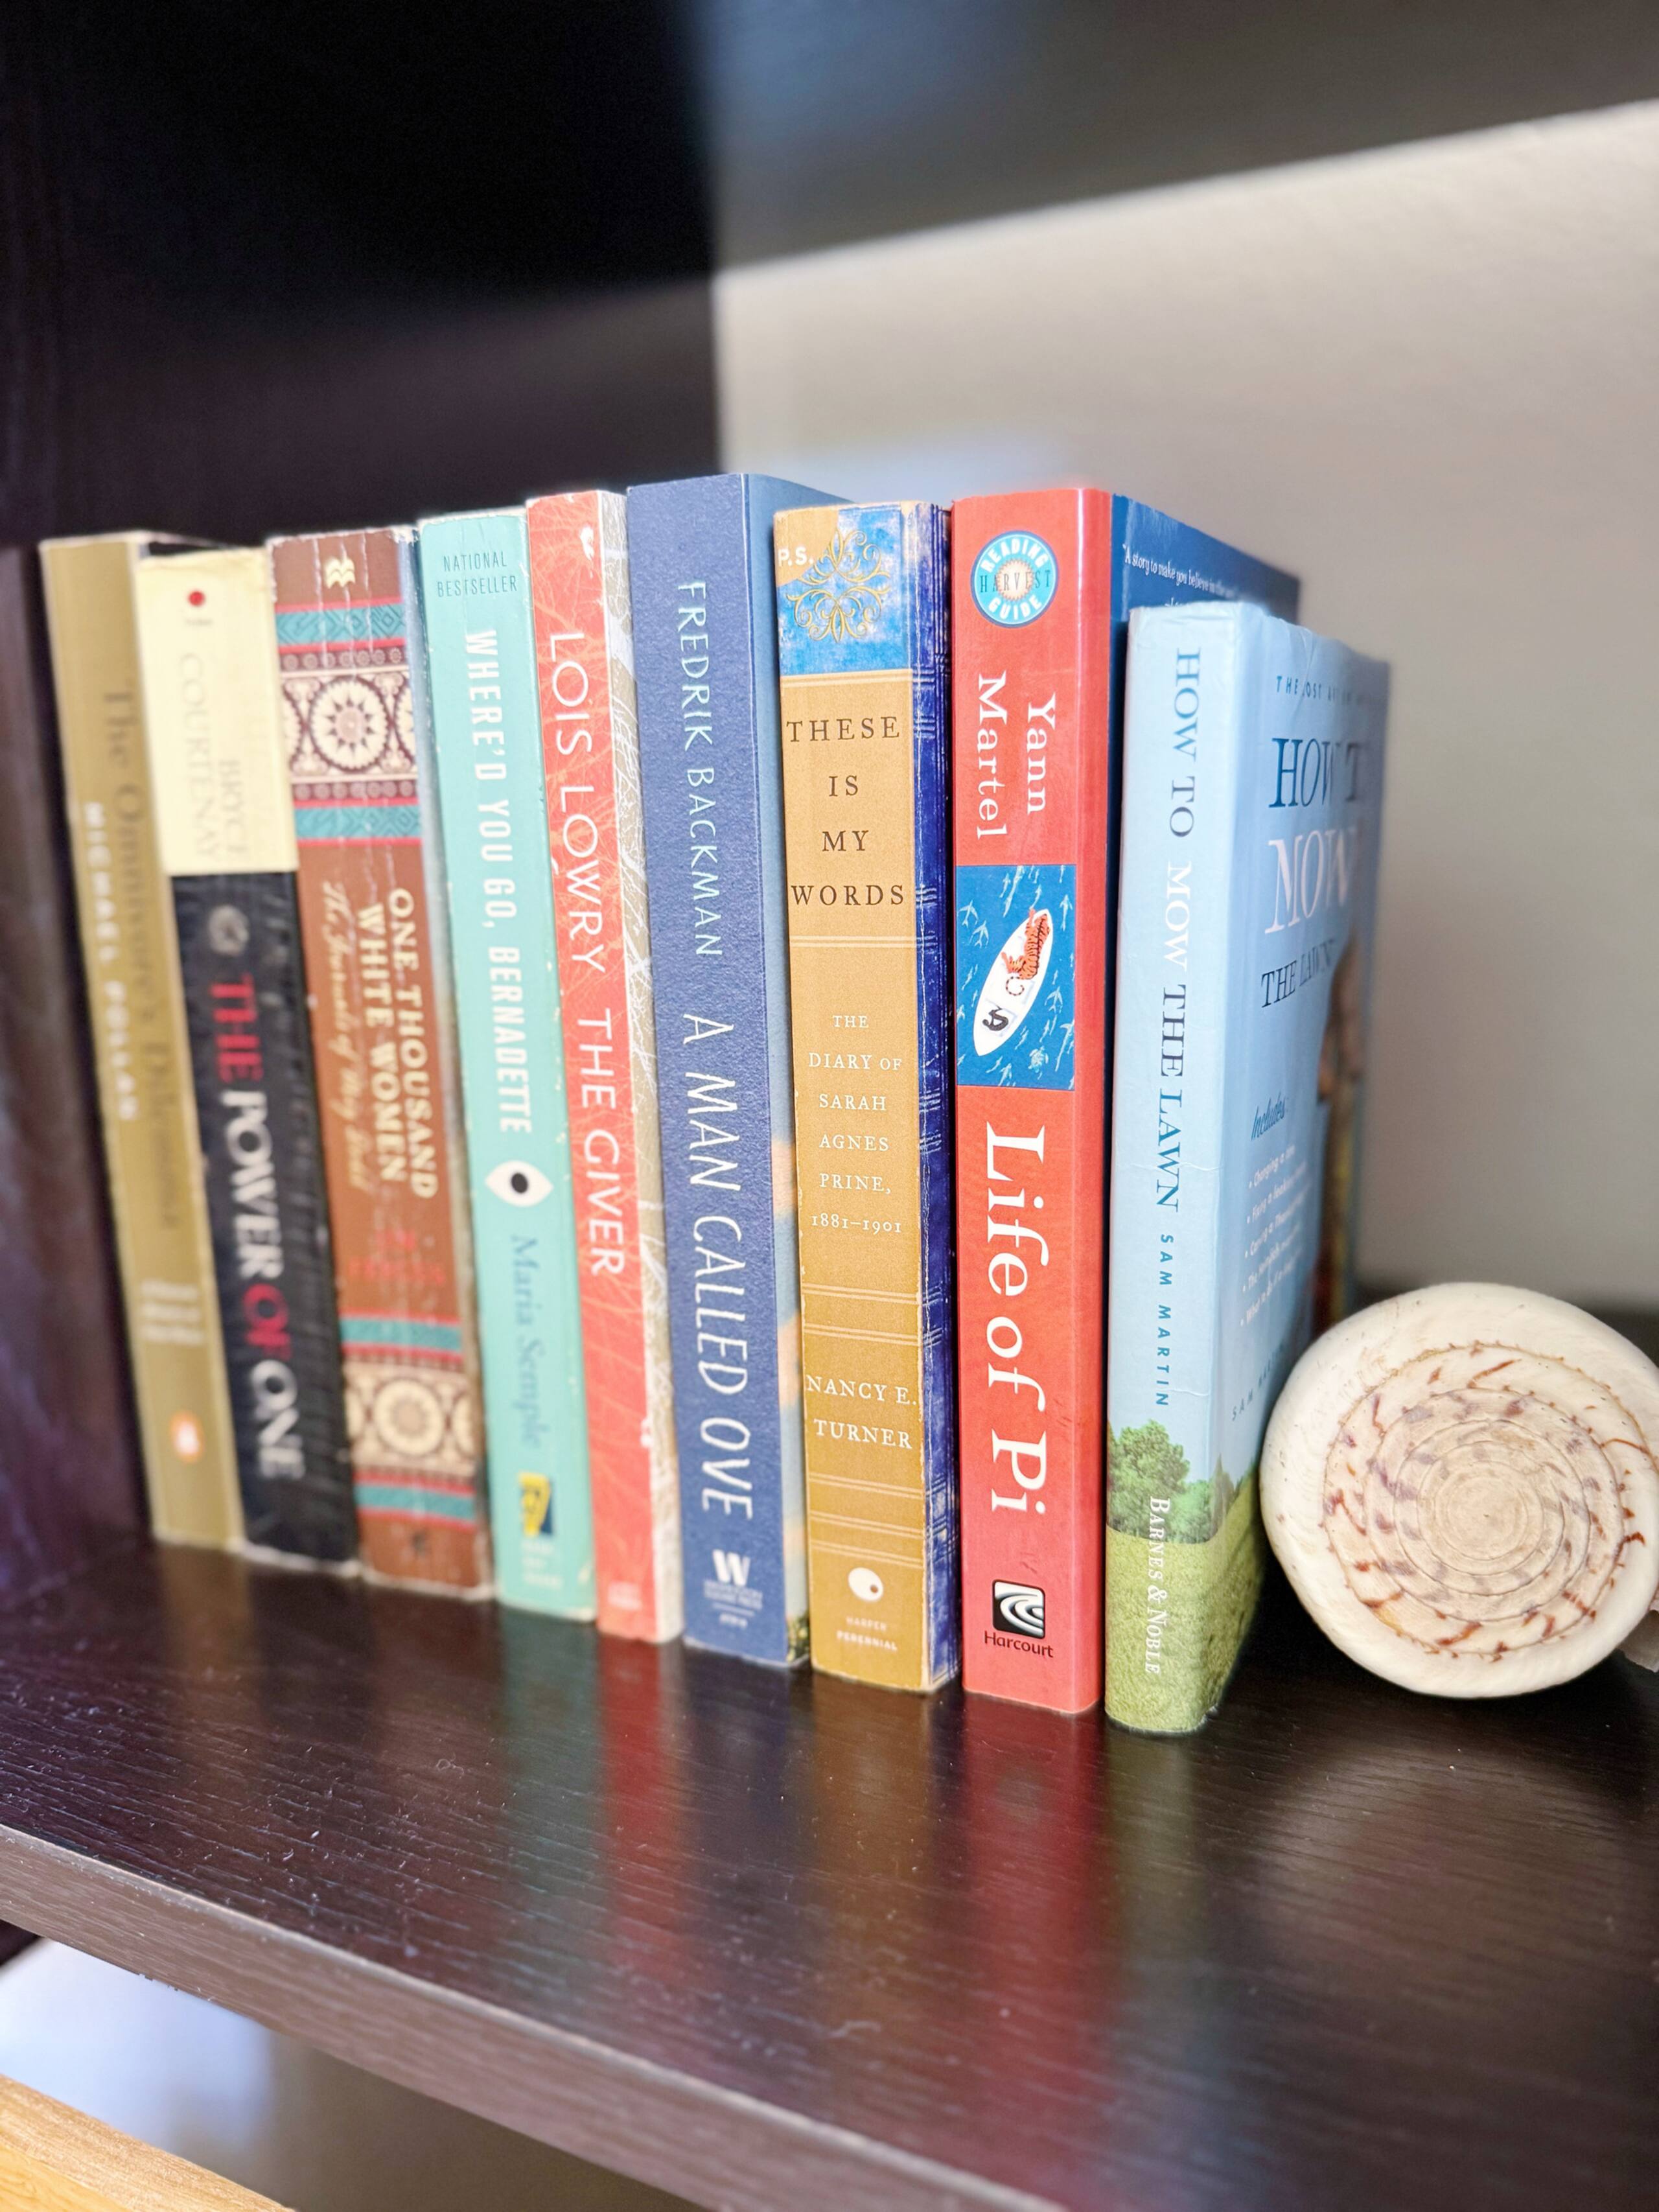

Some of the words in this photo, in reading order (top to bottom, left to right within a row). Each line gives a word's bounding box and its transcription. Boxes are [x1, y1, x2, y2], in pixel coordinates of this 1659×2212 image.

[437, 575, 518, 598] BESTSELLER
[443, 551, 507, 572] NATIONAL
[778, 546, 814, 566] P.S.
[980, 538, 1050, 573] READING
[980, 569, 1051, 593] HARVEST
[1131, 552, 1150, 576] story
[1150, 560, 1158, 574] to
[1158, 559, 1176, 579] make
[1176, 570, 1187, 586] you
[988, 594, 1042, 620] GUIDE
[550, 631, 594, 756] LOIS
[677, 581, 713, 752] FREDRIK
[1276, 675, 1299, 695] THE
[786, 716, 901, 743] THESE
[1172, 647, 1201, 763] HOW
[828, 774, 860, 797] IS
[977, 669, 1008, 842] Martel
[1027, 692, 1057, 815] Yann
[1268, 737, 1341, 808] HOW
[478, 799, 513, 863] YOU
[822, 830, 869, 852] MY
[1168, 775, 1196, 838] TO
[559, 784, 606, 973] LOWRY
[686, 767, 723, 957] BACKMAN
[791, 883, 905, 907] WORDS
[389, 888, 421, 971] ONE
[481, 878, 518, 929] GO,
[1163, 859, 1192, 972] MOW
[358, 903, 394, 1028] WHITE
[1260, 960, 1297, 1008] THE
[210, 973, 264, 1083] THE
[488, 945, 533, 1133] BERNADETTE
[682, 1012, 735, 1045] A
[832, 1014, 869, 1029] THE
[1160, 984, 1187, 1078] THE
[393, 984, 439, 1199] THOUSAND
[577, 1008, 617, 1110] THE
[808, 1052, 873, 1071] DIARY
[879, 1056, 903, 1071] OF
[368, 1041, 409, 1182] WOMEN
[684, 1071, 742, 1192] MAN
[818, 1093, 887, 1112] SARAH
[818, 1134, 890, 1152] AGNES
[1156, 1088, 1183, 1212] LAWN
[221, 1089, 284, 1281] POWER
[583, 1128, 626, 1277] GIVER
[819, 1172, 892, 1195] PRINE,
[986, 1120, 1049, 1298] Life
[511, 1234, 540, 1327] Maria
[1159, 1233, 1174, 1286] SAM
[242, 1283, 292, 1360] OF
[691, 1214, 749, 1395] CALLED
[512, 1334, 546, 1450] Semple
[806, 1373, 887, 1401] NANCY
[896, 1387, 917, 1406] E.
[986, 1314, 1047, 1413] of
[1155, 1304, 1172, 1407] MARTIN
[250, 1360, 305, 1480] ONE
[814, 1418, 912, 1450] TURNER
[700, 1416, 754, 1520] OVE
[990, 1428, 1048, 1516] Pi
[1148, 1495, 1170, 1581] BARNES
[845, 1616, 887, 1632] HARPER
[1147, 1583, 1168, 1602] &
[836, 1629, 898, 1653] PERENNIAL
[983, 1629, 1055, 1659] Harcourt
[1144, 1609, 1168, 1676] NOBLE
